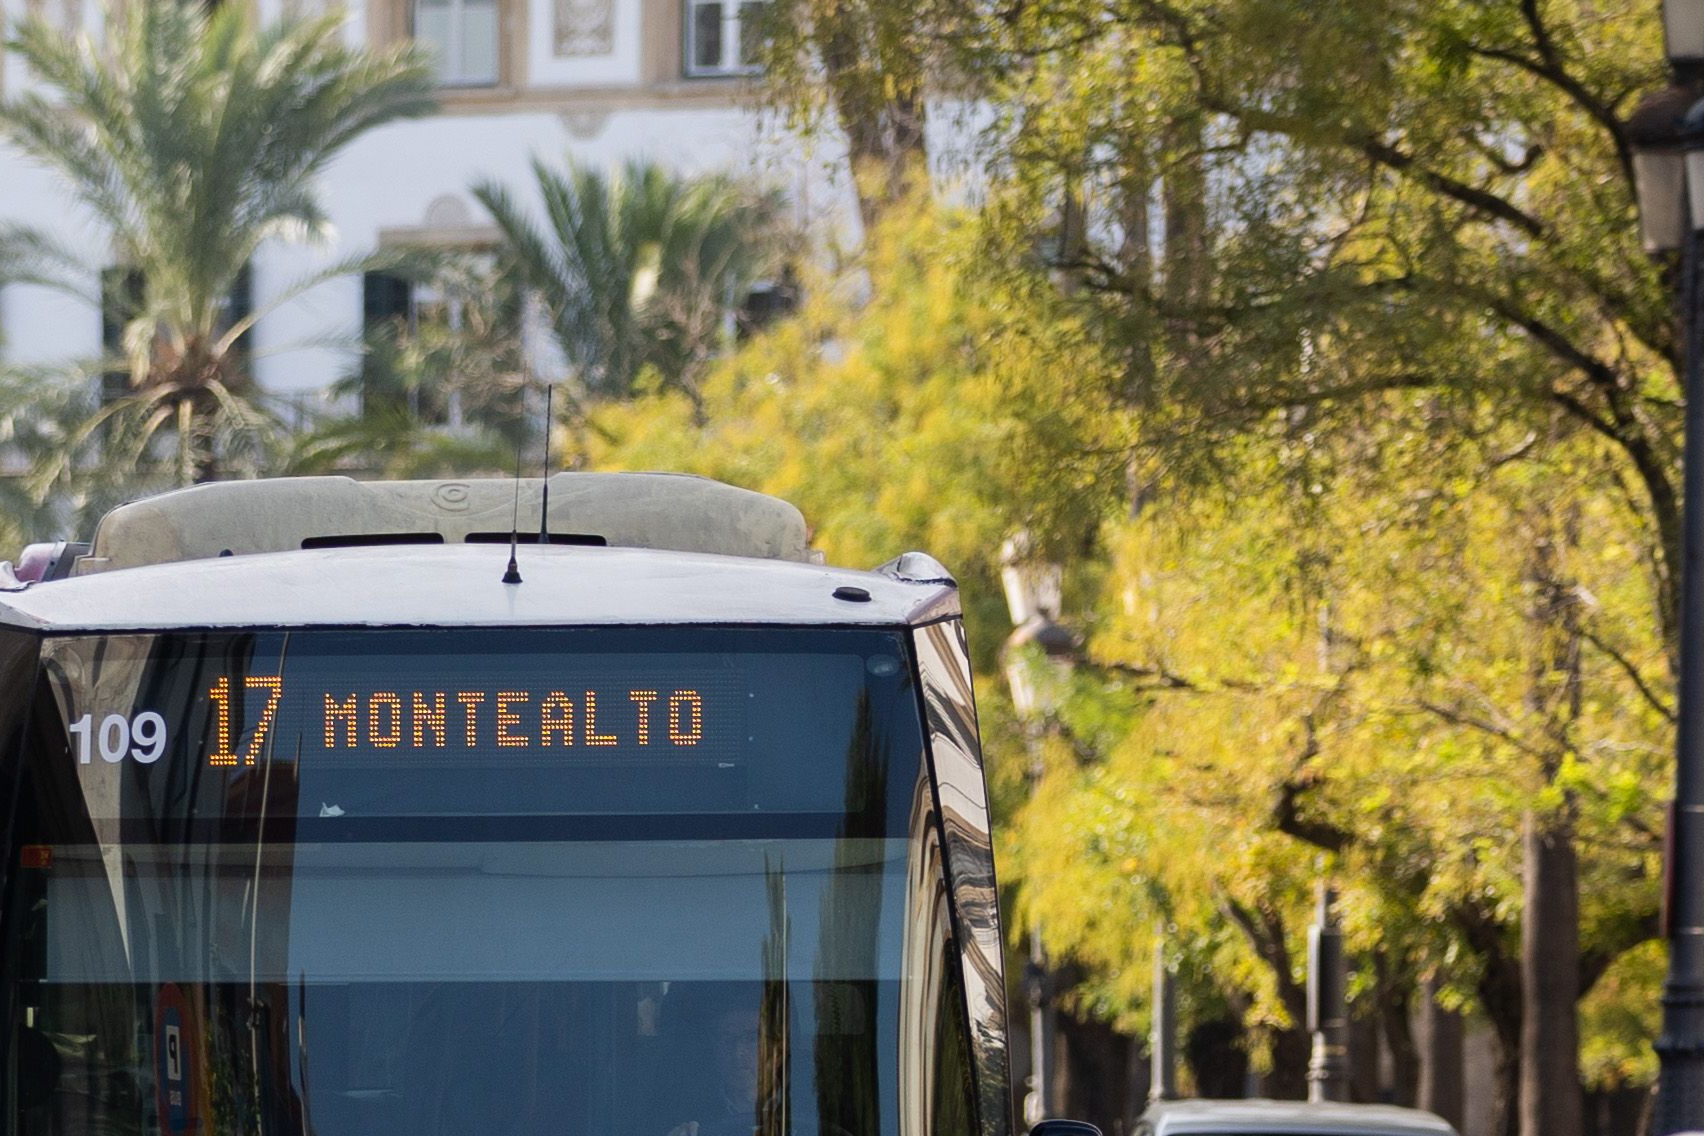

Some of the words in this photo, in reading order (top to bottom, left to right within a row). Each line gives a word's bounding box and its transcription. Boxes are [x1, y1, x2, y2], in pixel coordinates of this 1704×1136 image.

[69, 711, 167, 764] 109
[209, 676, 282, 766] 17
[324, 690, 702, 748] MONTEALTO
